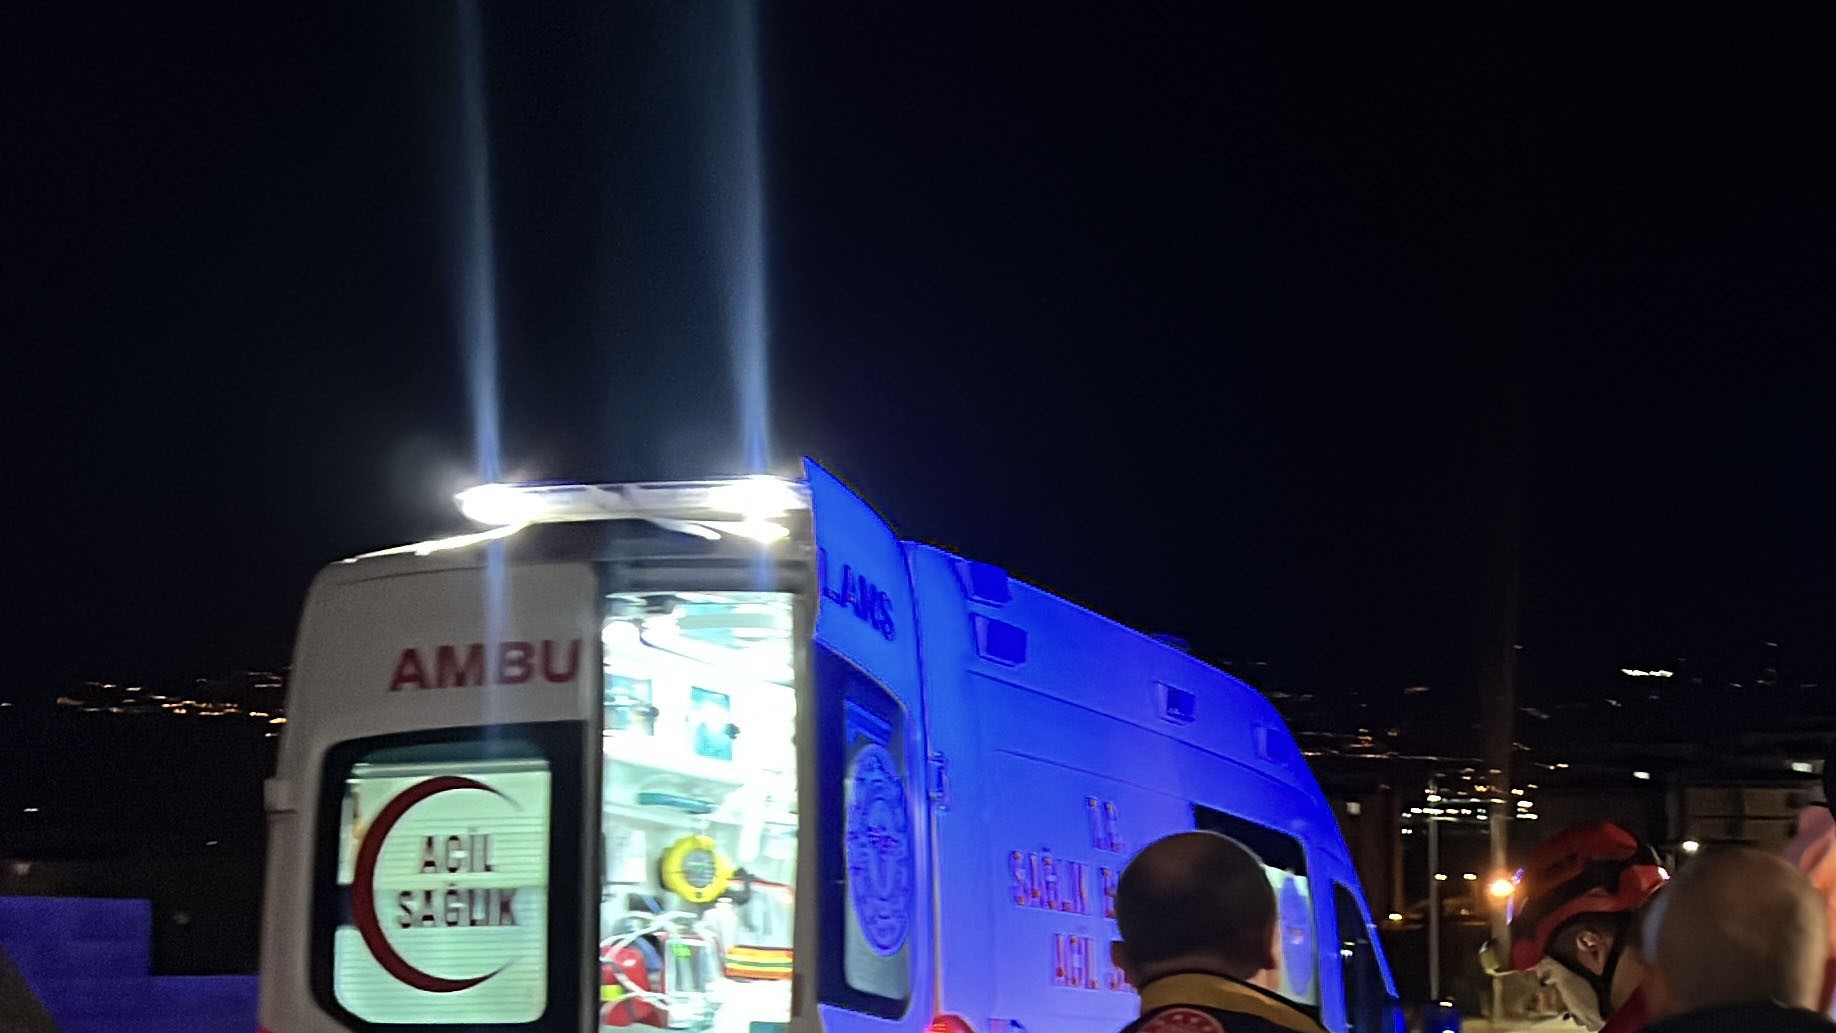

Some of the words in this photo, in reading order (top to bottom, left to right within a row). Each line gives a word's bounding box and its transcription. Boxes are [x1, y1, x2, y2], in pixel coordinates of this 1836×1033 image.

[390, 638, 582, 691] AMBU
[419, 826, 494, 873] ACİL
[398, 881, 519, 928] SAĞLIK
